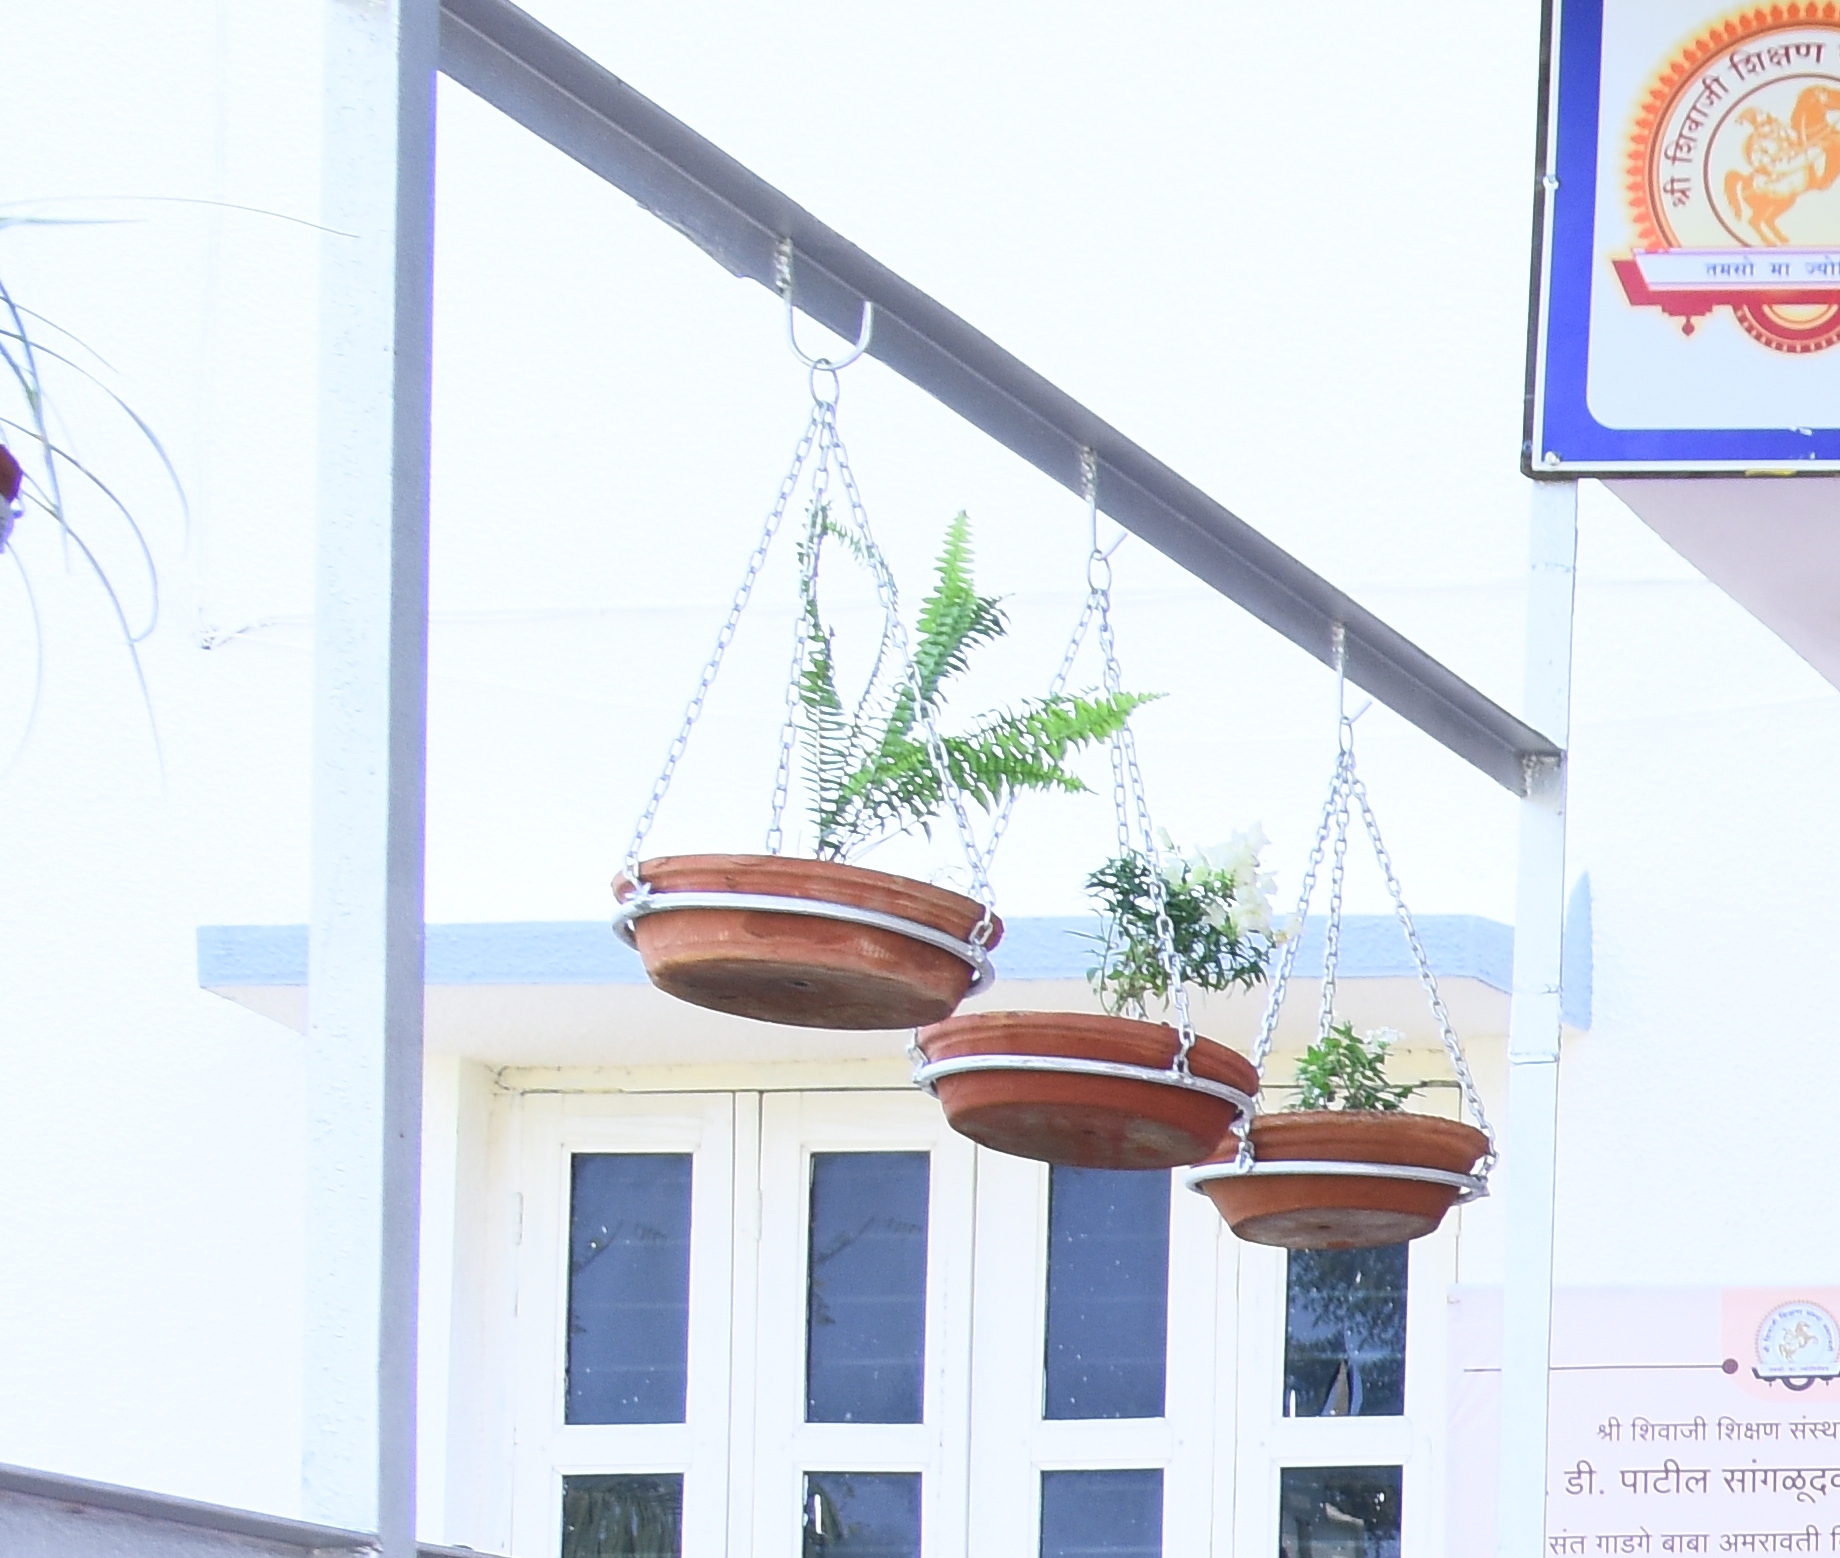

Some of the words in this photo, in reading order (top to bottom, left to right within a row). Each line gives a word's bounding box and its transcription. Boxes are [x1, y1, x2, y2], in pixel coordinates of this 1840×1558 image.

[1727, 41, 1826, 82] शिक्षण
[1664, 75, 1731, 167] शिवाजी
[1664, 176, 1692, 208] श्री
[1597, 1416, 1622, 1442] श्री
[1631, 1415, 1708, 1441] शिवाजी
[1717, 1416, 1781, 1440] शिक्षण
[1564, 1460, 1605, 1496] डी.
[1620, 1458, 1711, 1494] पाटील
[1548, 1528, 1587, 1554] संत
[1596, 1525, 1652, 1553] गाडगे
[1661, 1534, 1711, 1553] बाबा
[1719, 1524, 1822, 1553] अमरावती
